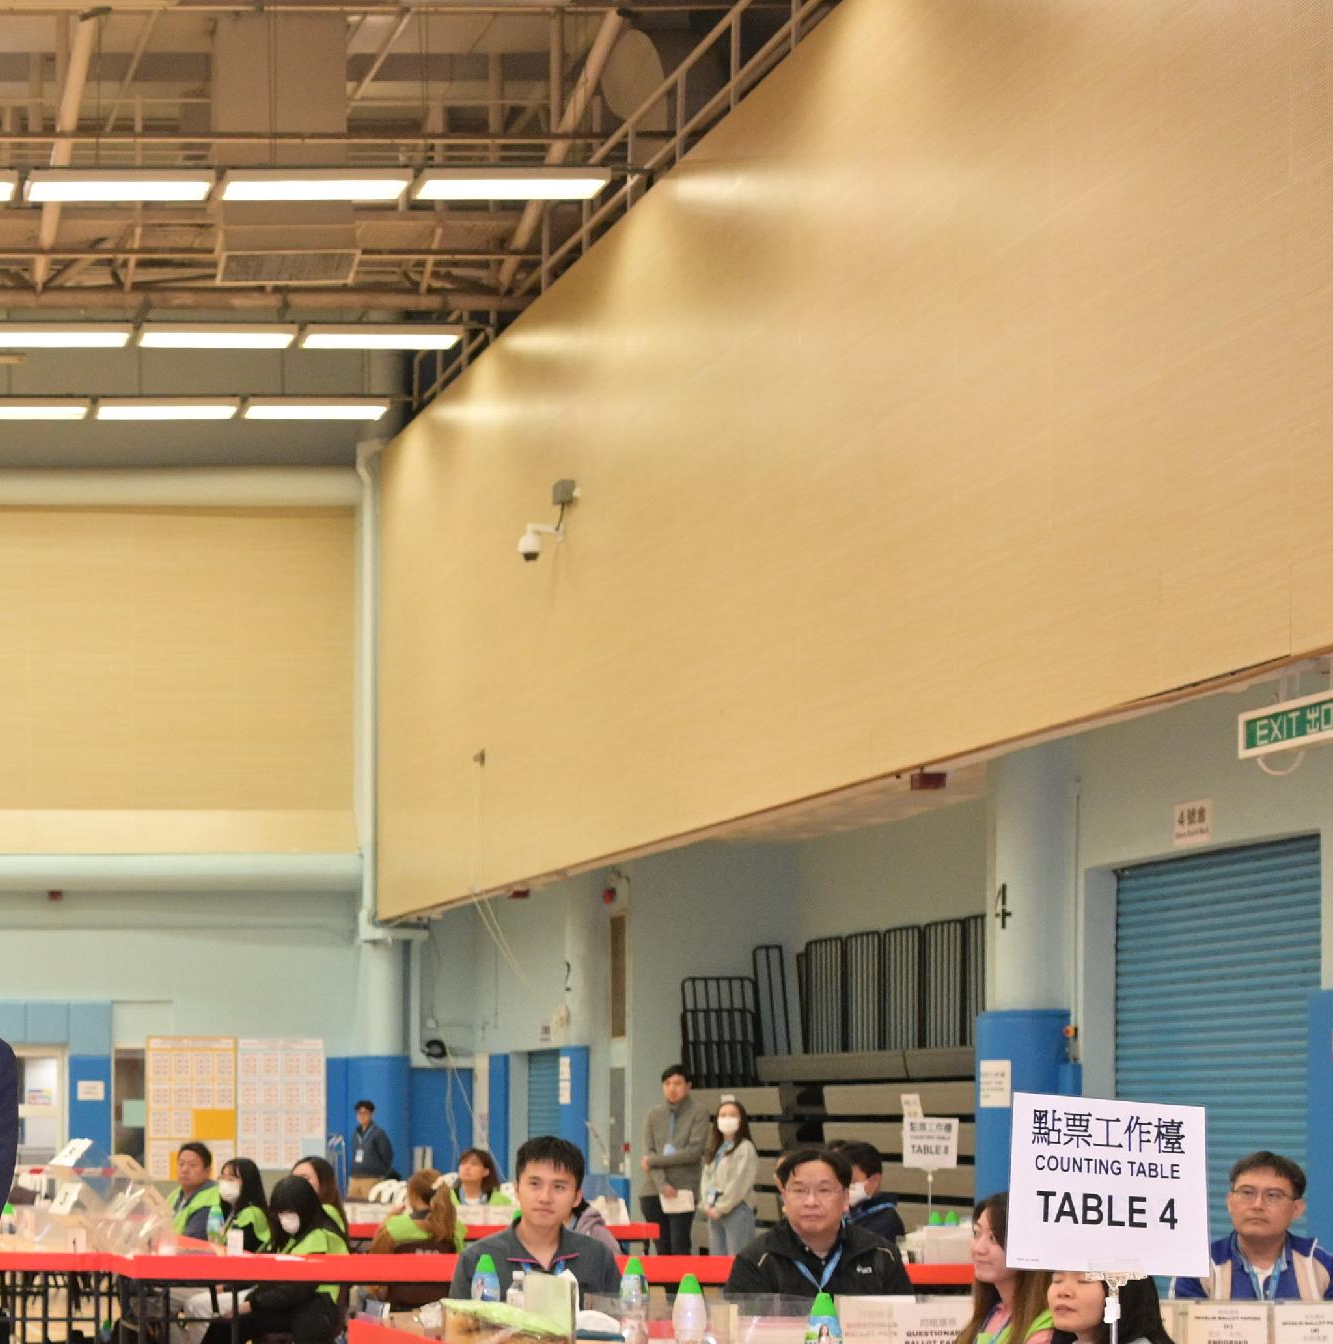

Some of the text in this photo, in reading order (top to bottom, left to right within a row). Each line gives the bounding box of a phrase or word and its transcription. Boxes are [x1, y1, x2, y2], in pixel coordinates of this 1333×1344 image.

[1256, 711, 1301, 745] EXIT
[1031, 1108, 1186, 1155] 點票工作檯
[911, 1144, 941, 1156] TABLE
[1035, 1154, 1181, 1180] COUNTING TABLE
[1036, 1190, 1179, 1230] TABLE 4
